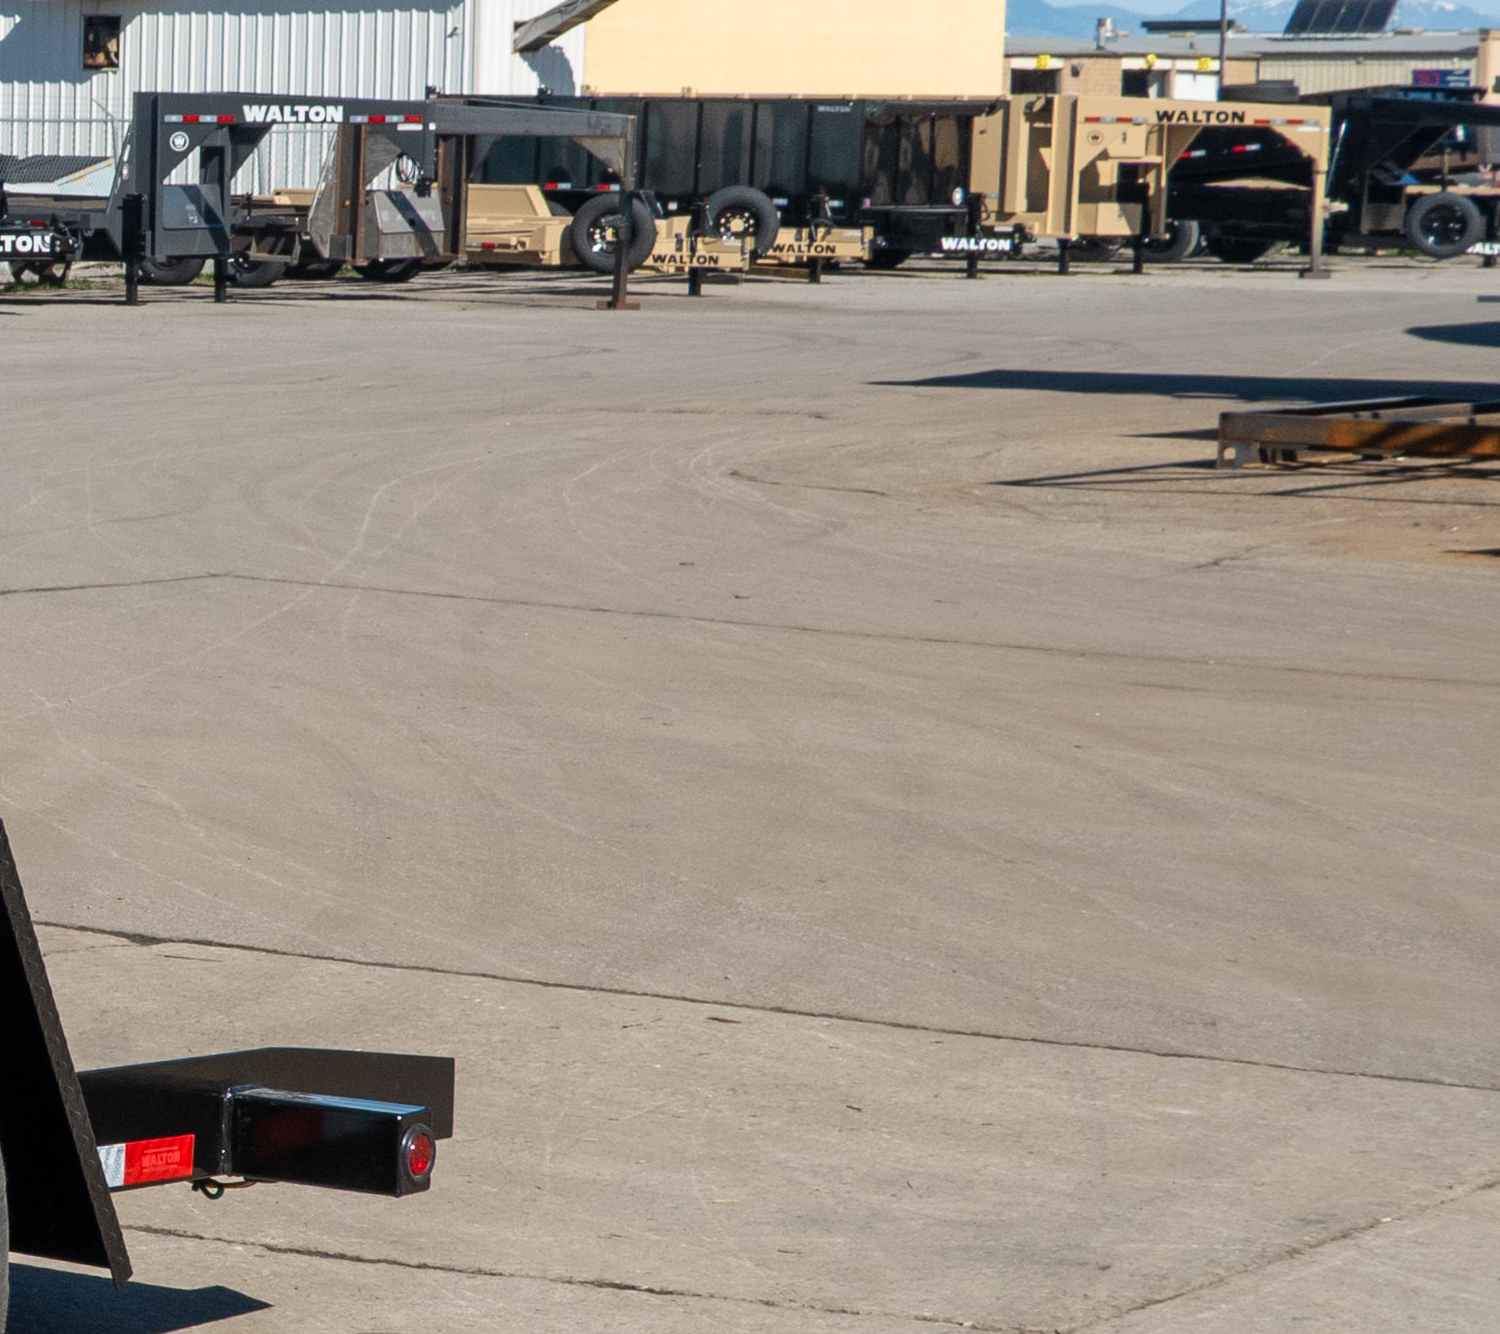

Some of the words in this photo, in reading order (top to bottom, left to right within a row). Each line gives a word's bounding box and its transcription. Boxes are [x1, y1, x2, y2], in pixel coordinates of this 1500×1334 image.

[243, 105, 343, 122] WALTON
[1156, 110, 1246, 123] WALTON
[773, 243, 836, 254] WALTON
[941, 237, 1014, 251] WALTON
[652, 254, 719, 266] WALTON
[141, 1150, 181, 1168] WALTON
